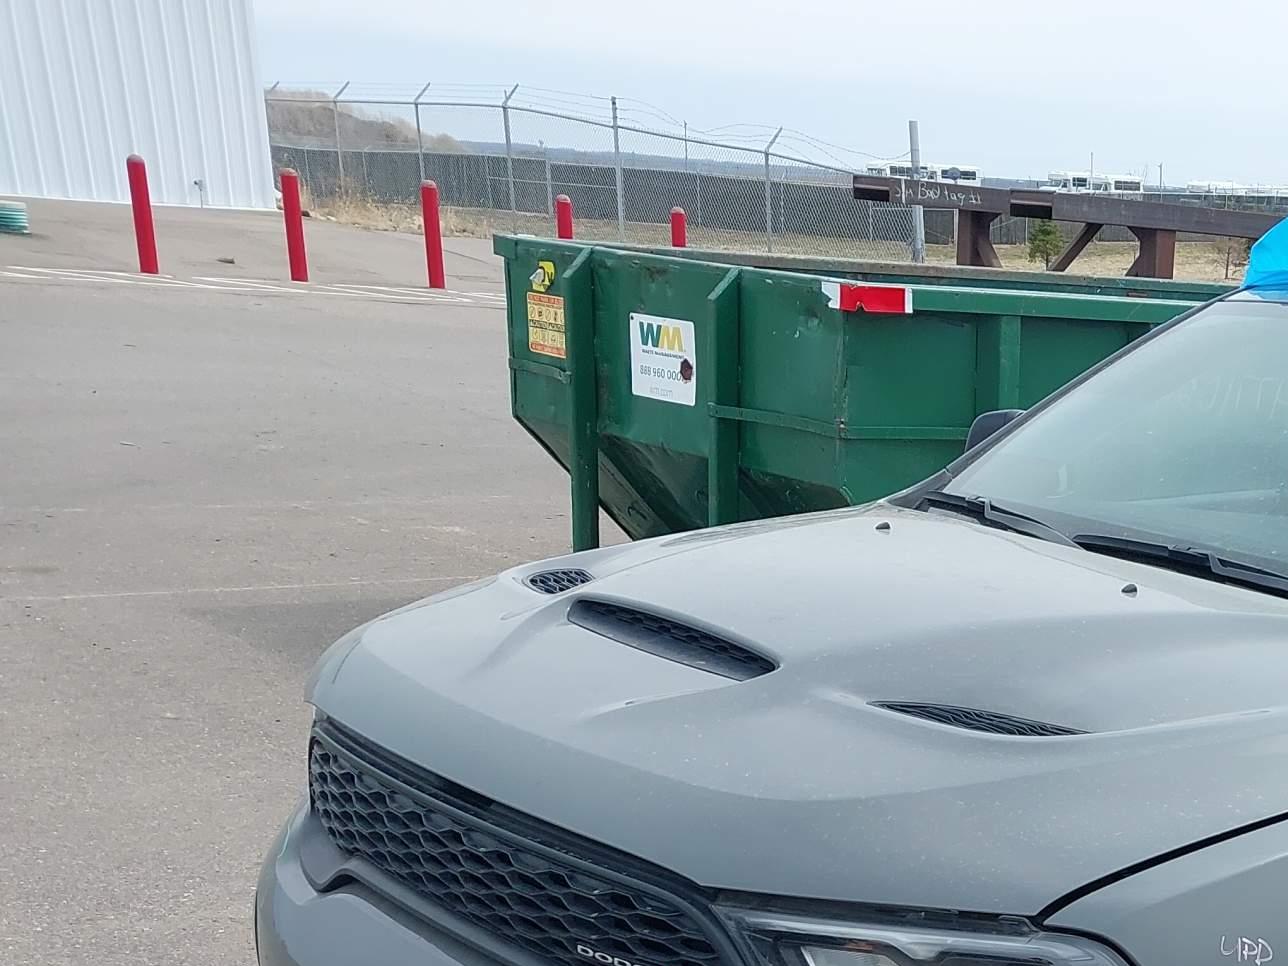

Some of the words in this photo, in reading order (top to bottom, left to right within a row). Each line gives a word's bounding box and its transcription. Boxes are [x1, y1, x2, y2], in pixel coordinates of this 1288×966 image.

[639, 321, 684, 352] WM
[652, 368, 665, 379] 960
[1220, 935, 1273, 966] UPD
